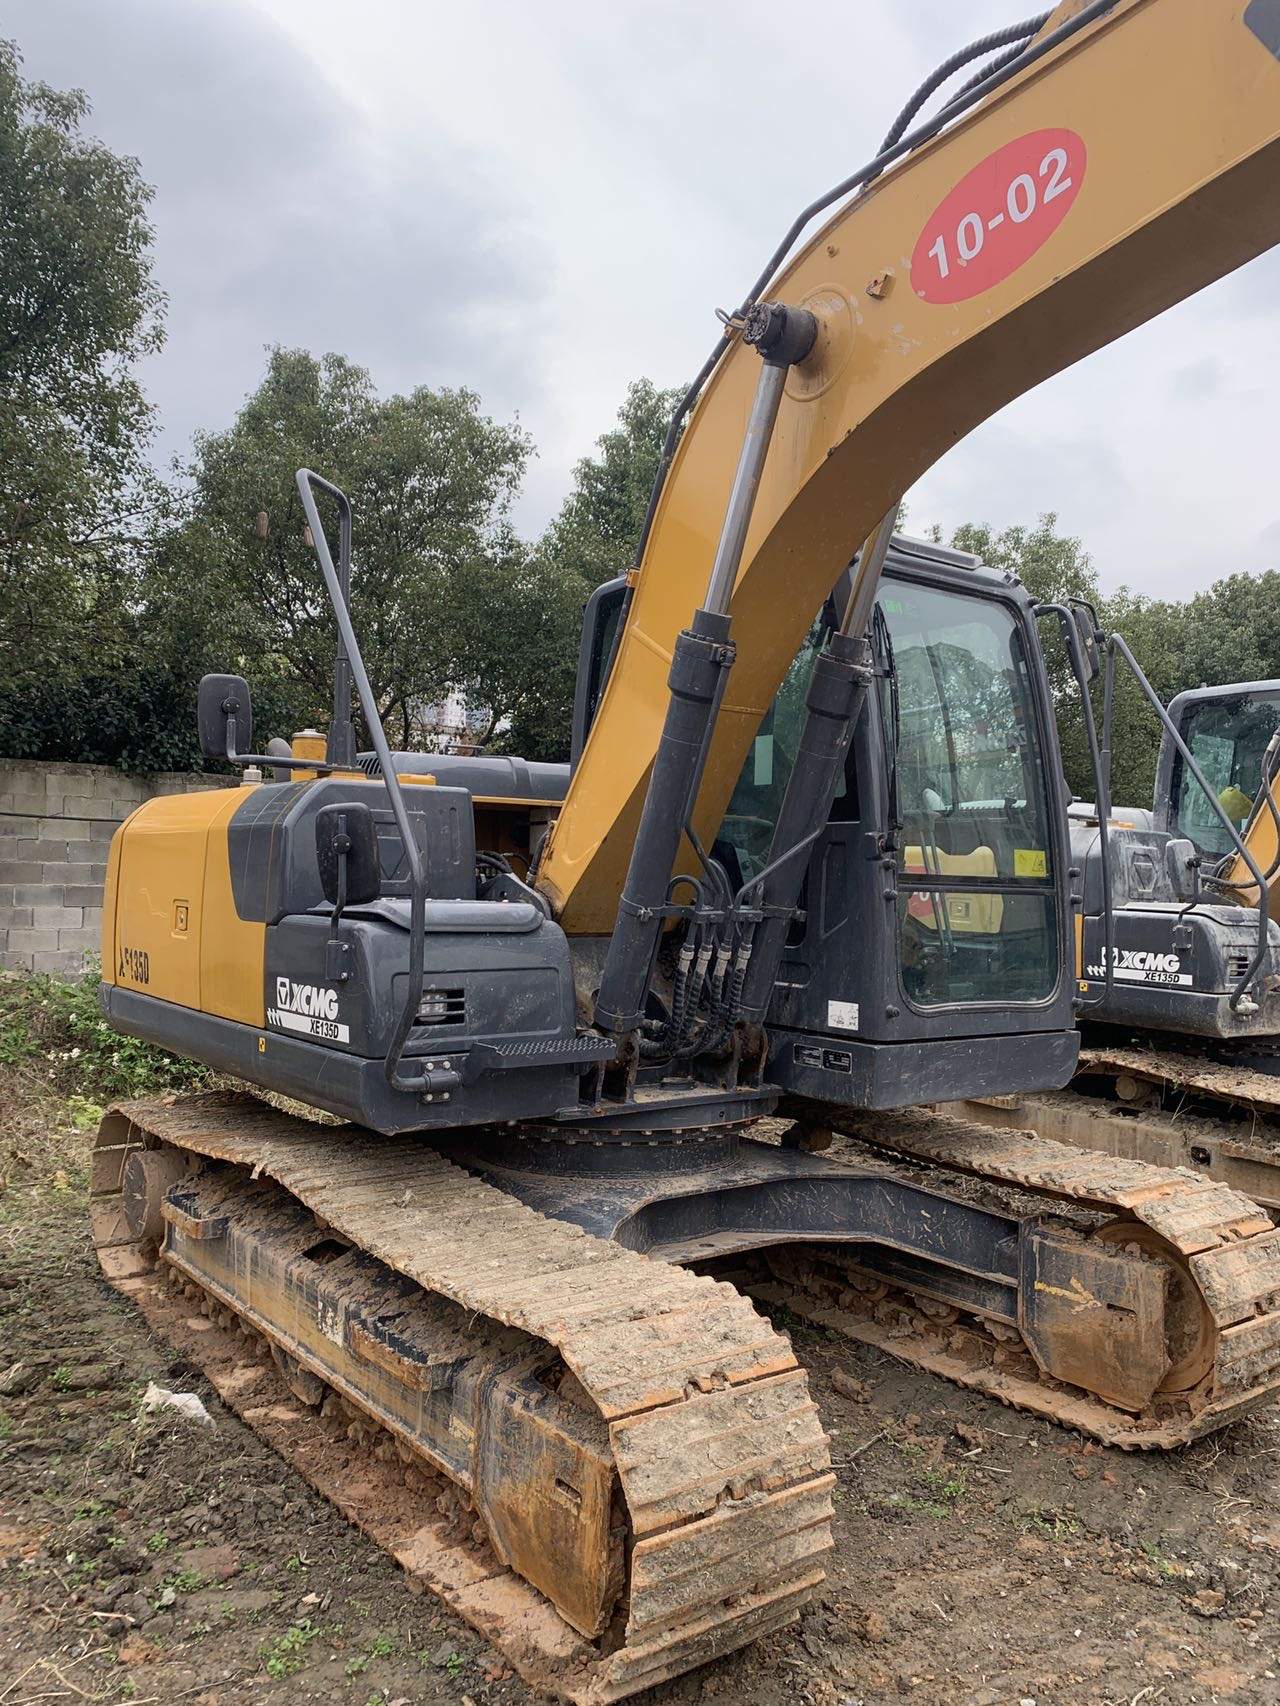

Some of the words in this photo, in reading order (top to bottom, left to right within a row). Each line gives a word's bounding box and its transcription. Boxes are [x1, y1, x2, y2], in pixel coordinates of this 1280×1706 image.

[928, 148, 1072, 278] 10-02
[1118, 950, 1180, 973] XCMG
[1144, 971, 1180, 983] XE135D
[290, 982, 339, 1020] XCMG
[310, 1018, 339, 1039] XE135D
